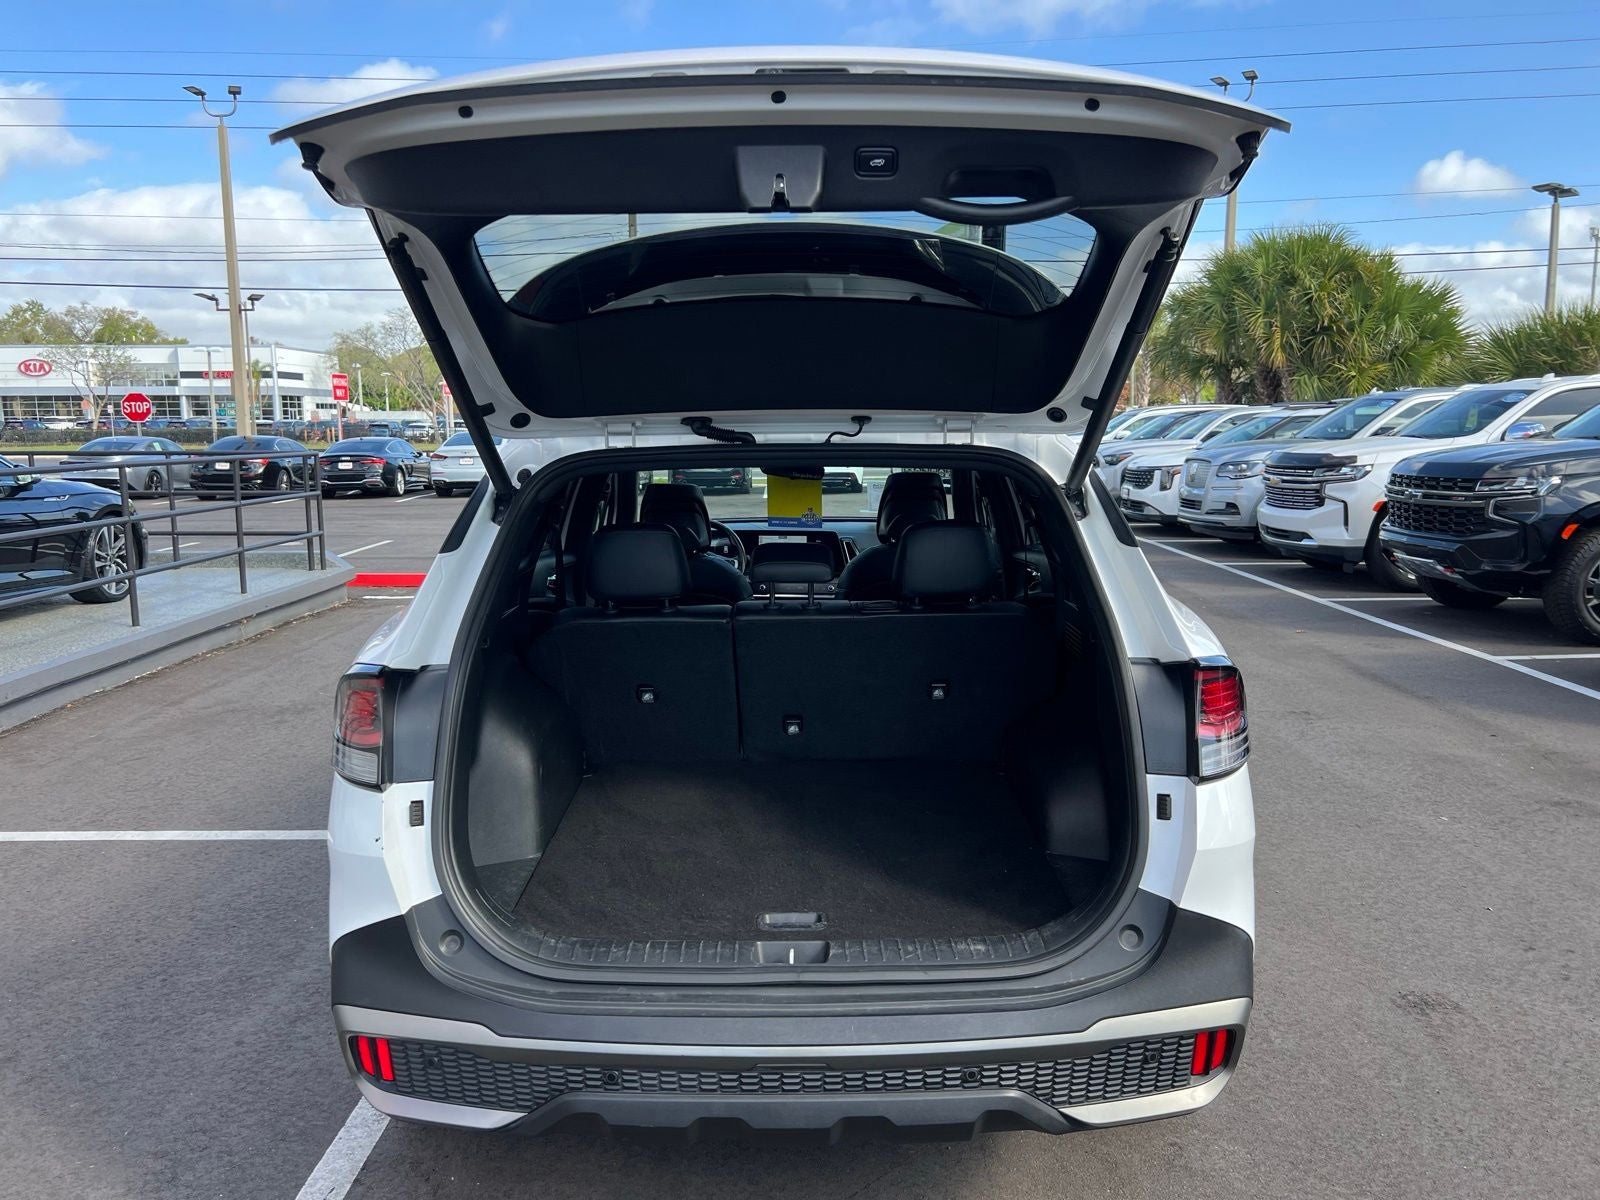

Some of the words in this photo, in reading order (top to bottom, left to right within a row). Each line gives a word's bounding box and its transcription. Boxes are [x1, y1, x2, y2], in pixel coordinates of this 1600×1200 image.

[22, 361, 48, 373] KIA
[335, 388, 346, 398] WAY
[123, 401, 150, 413] STOP
